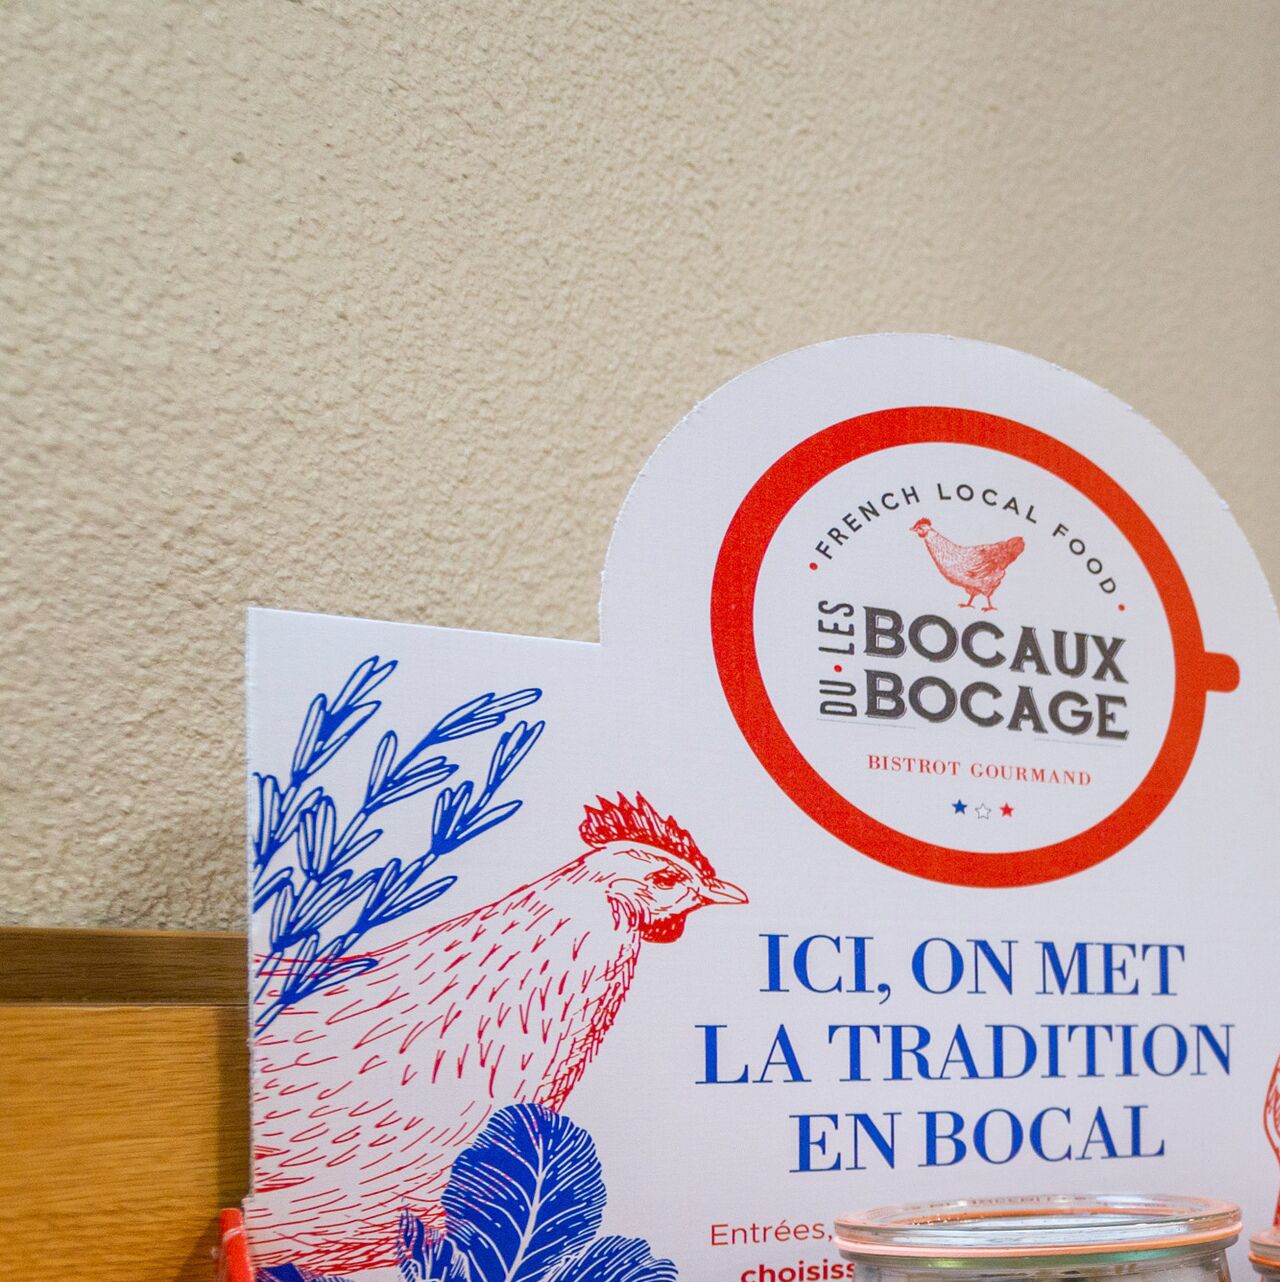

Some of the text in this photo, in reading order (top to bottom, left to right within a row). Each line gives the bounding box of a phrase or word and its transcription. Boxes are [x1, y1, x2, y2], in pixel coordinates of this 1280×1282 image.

[815, 482, 1117, 595] FRENCH LOCAL FOOD
[818, 599, 1129, 684] LES BOCAUX
[819, 668, 1129, 740] DU BOCAGE
[868, 754, 1092, 786] BISTROT GOURMAND
[759, 932, 1186, 1005] ICI, ON MET
[694, 1022, 1236, 1085] LA TRADITION
[788, 1104, 1166, 1173] EN BOCAL
[711, 1219, 834, 1246] Entrées,
